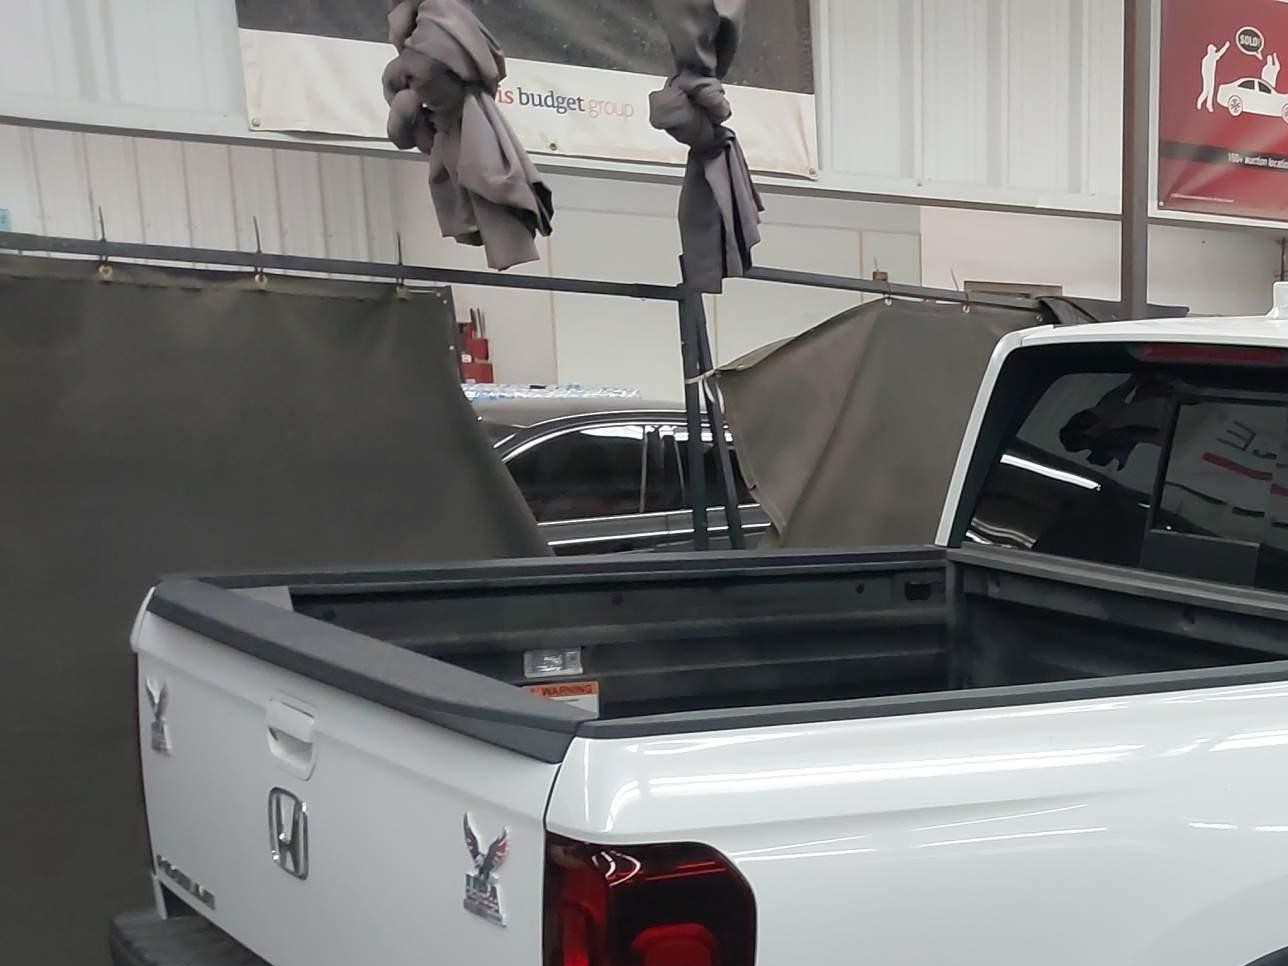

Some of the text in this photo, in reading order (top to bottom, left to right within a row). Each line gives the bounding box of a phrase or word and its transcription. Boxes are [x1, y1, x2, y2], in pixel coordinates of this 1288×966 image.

[498, 86, 634, 119] is budget group
